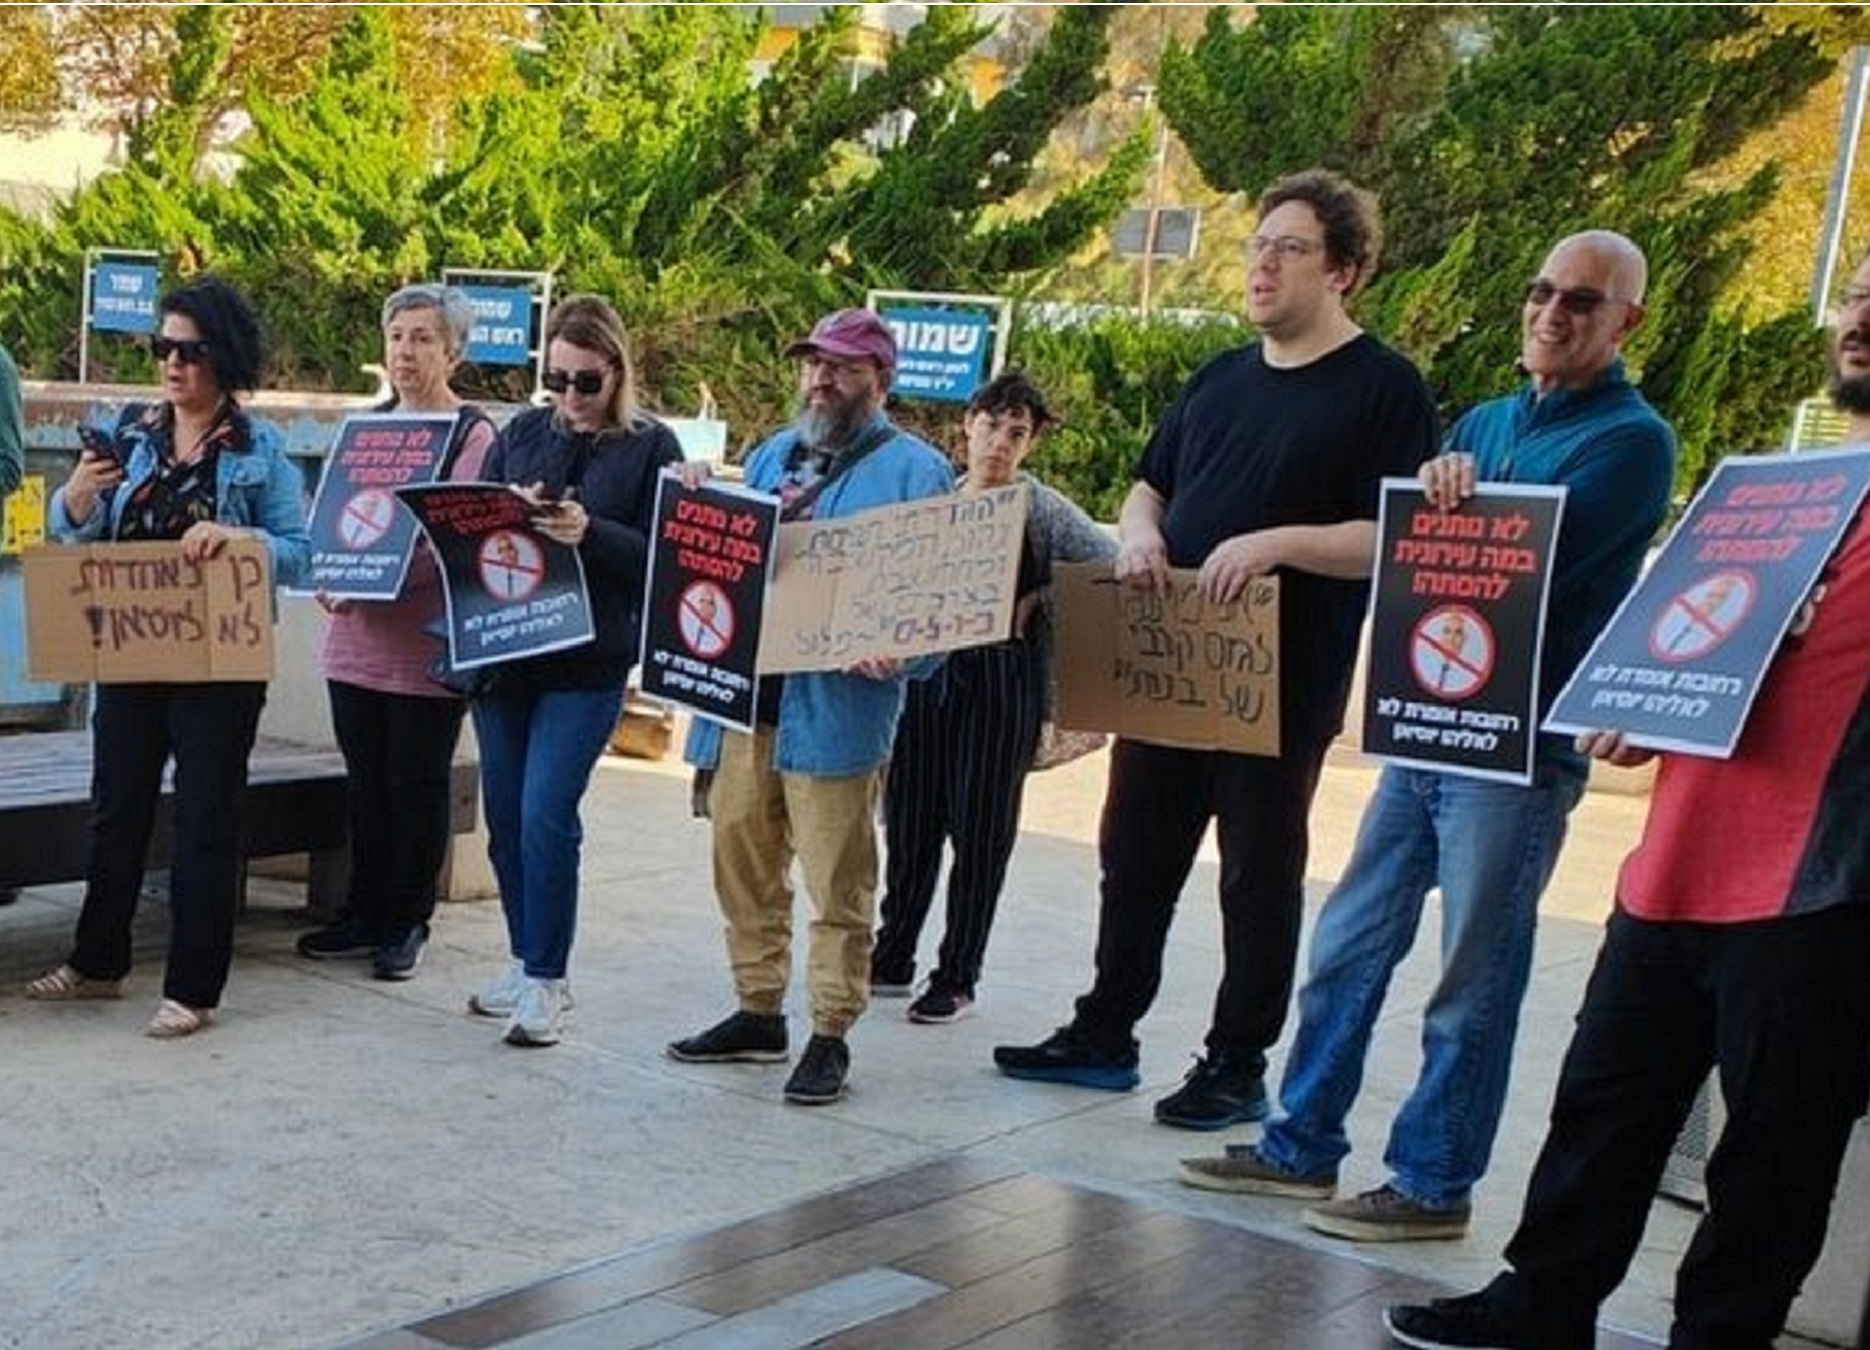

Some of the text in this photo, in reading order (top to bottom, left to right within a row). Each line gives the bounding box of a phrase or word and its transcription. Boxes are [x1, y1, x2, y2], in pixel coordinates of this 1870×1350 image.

[491, 327, 523, 345] ראש
[406, 429, 433, 447] לא
[1804, 474, 1847, 497] לא
[663, 520, 722, 551] עירונית
[730, 513, 758, 536] לא
[1412, 513, 1530, 541] לא נותנים
[723, 536, 761, 564] במה
[1394, 540, 1537, 574] במה עירונית
[229, 555, 262, 603] כן
[218, 601, 261, 647] לא
[464, 616, 483, 632] לא
[1589, 665, 1742, 695] רחובות אומרת לא
[1218, 671, 1265, 724] של
[1377, 698, 1520, 731] רחובות אומרת לא
